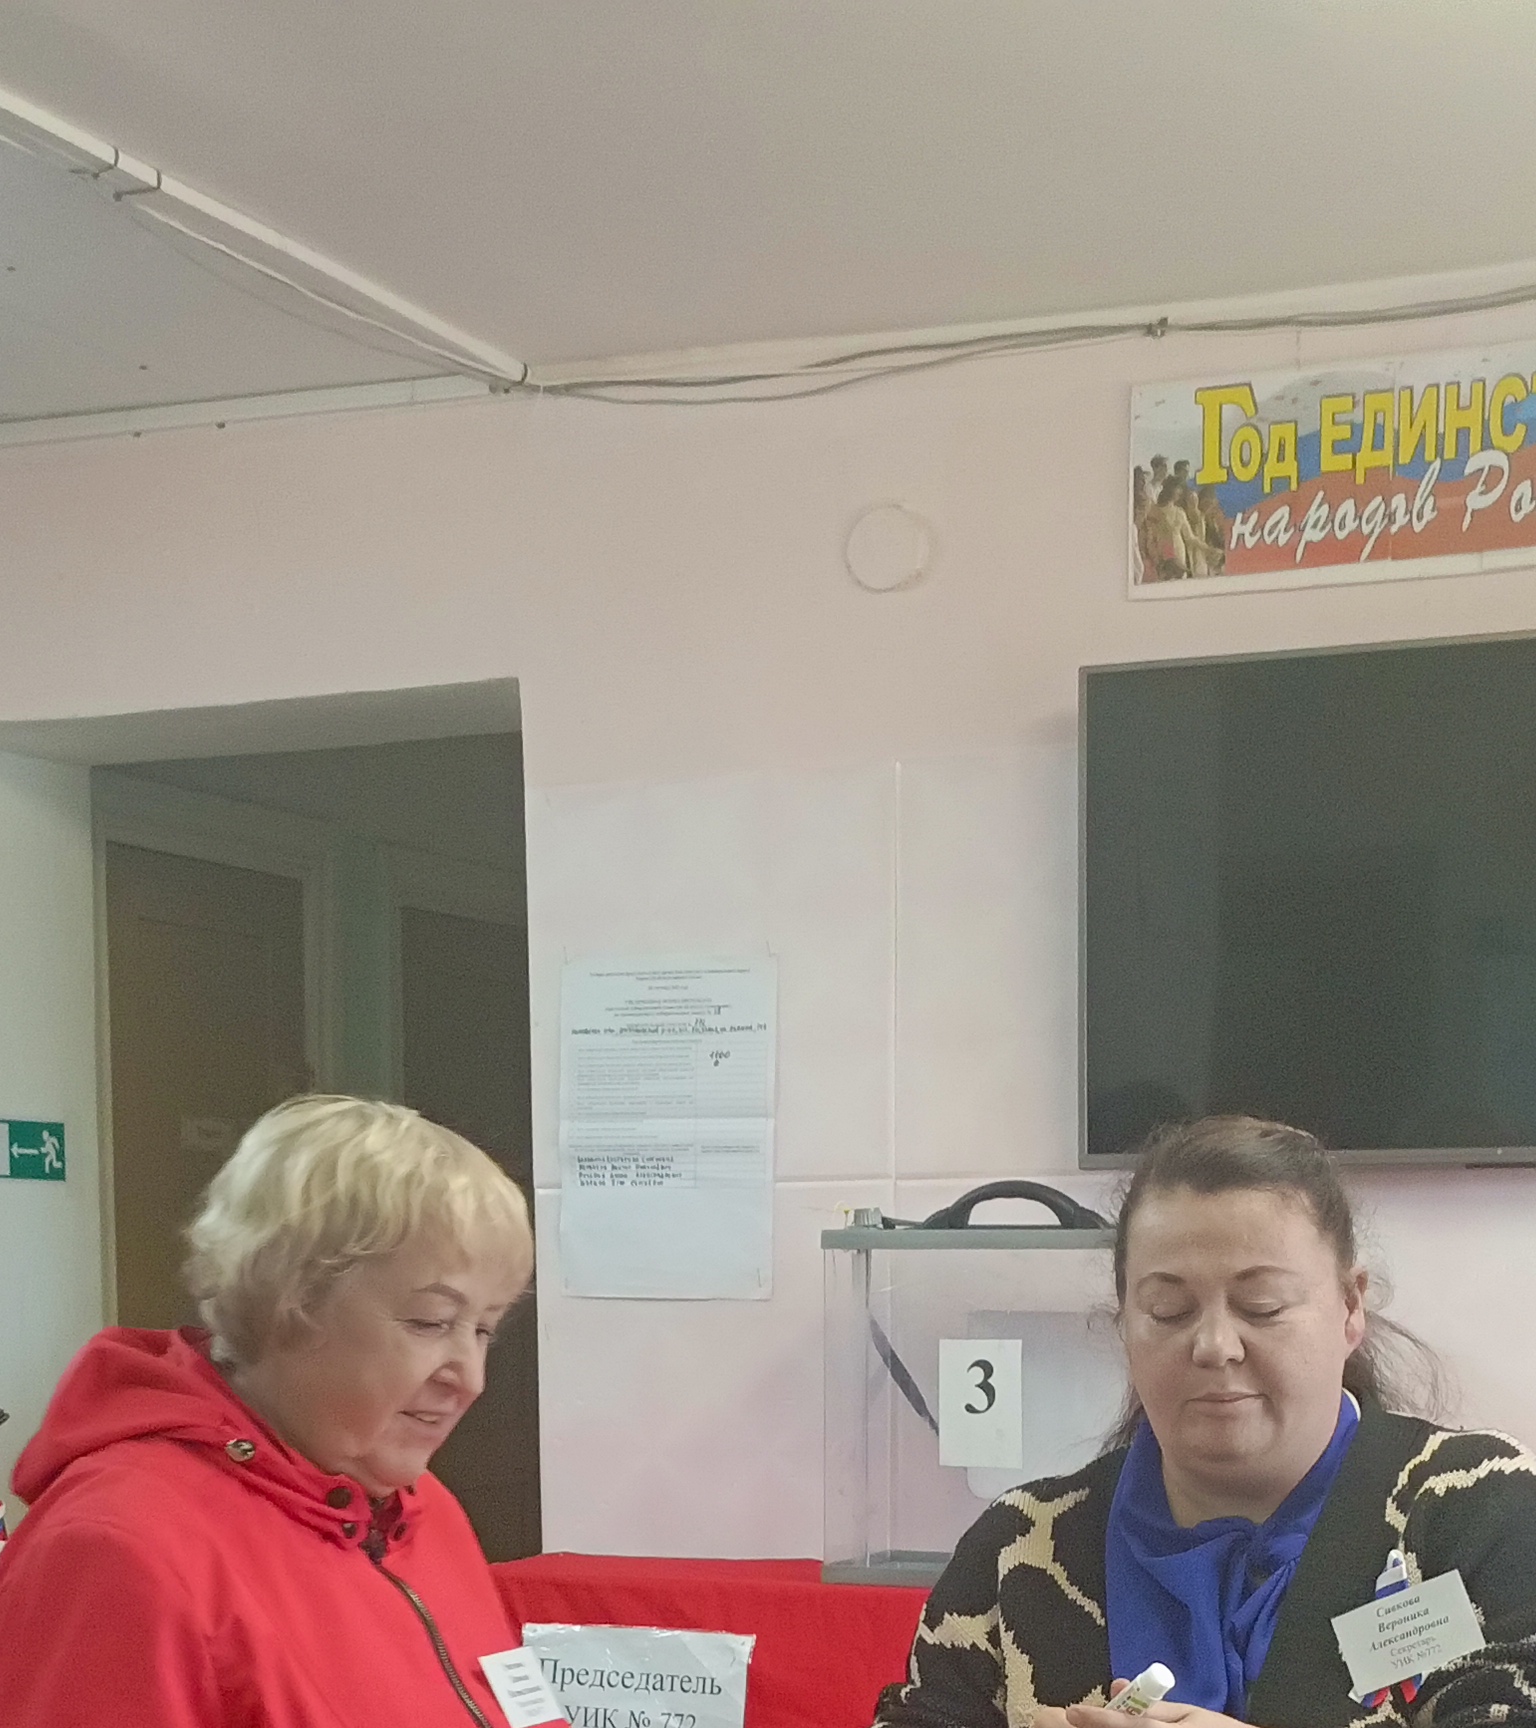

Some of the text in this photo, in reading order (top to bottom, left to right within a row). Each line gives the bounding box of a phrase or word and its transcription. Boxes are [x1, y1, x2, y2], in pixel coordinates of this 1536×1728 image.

[1194, 381, 1300, 494] Год
[1226, 456, 1439, 565] народов
[964, 1359, 997, 1415] 3
[1375, 1594, 1421, 1618] Сивкова
[1378, 1606, 1430, 1633] Вероника
[1368, 1614, 1450, 1652] Александровна
[538, 1657, 723, 1697] Председатель
